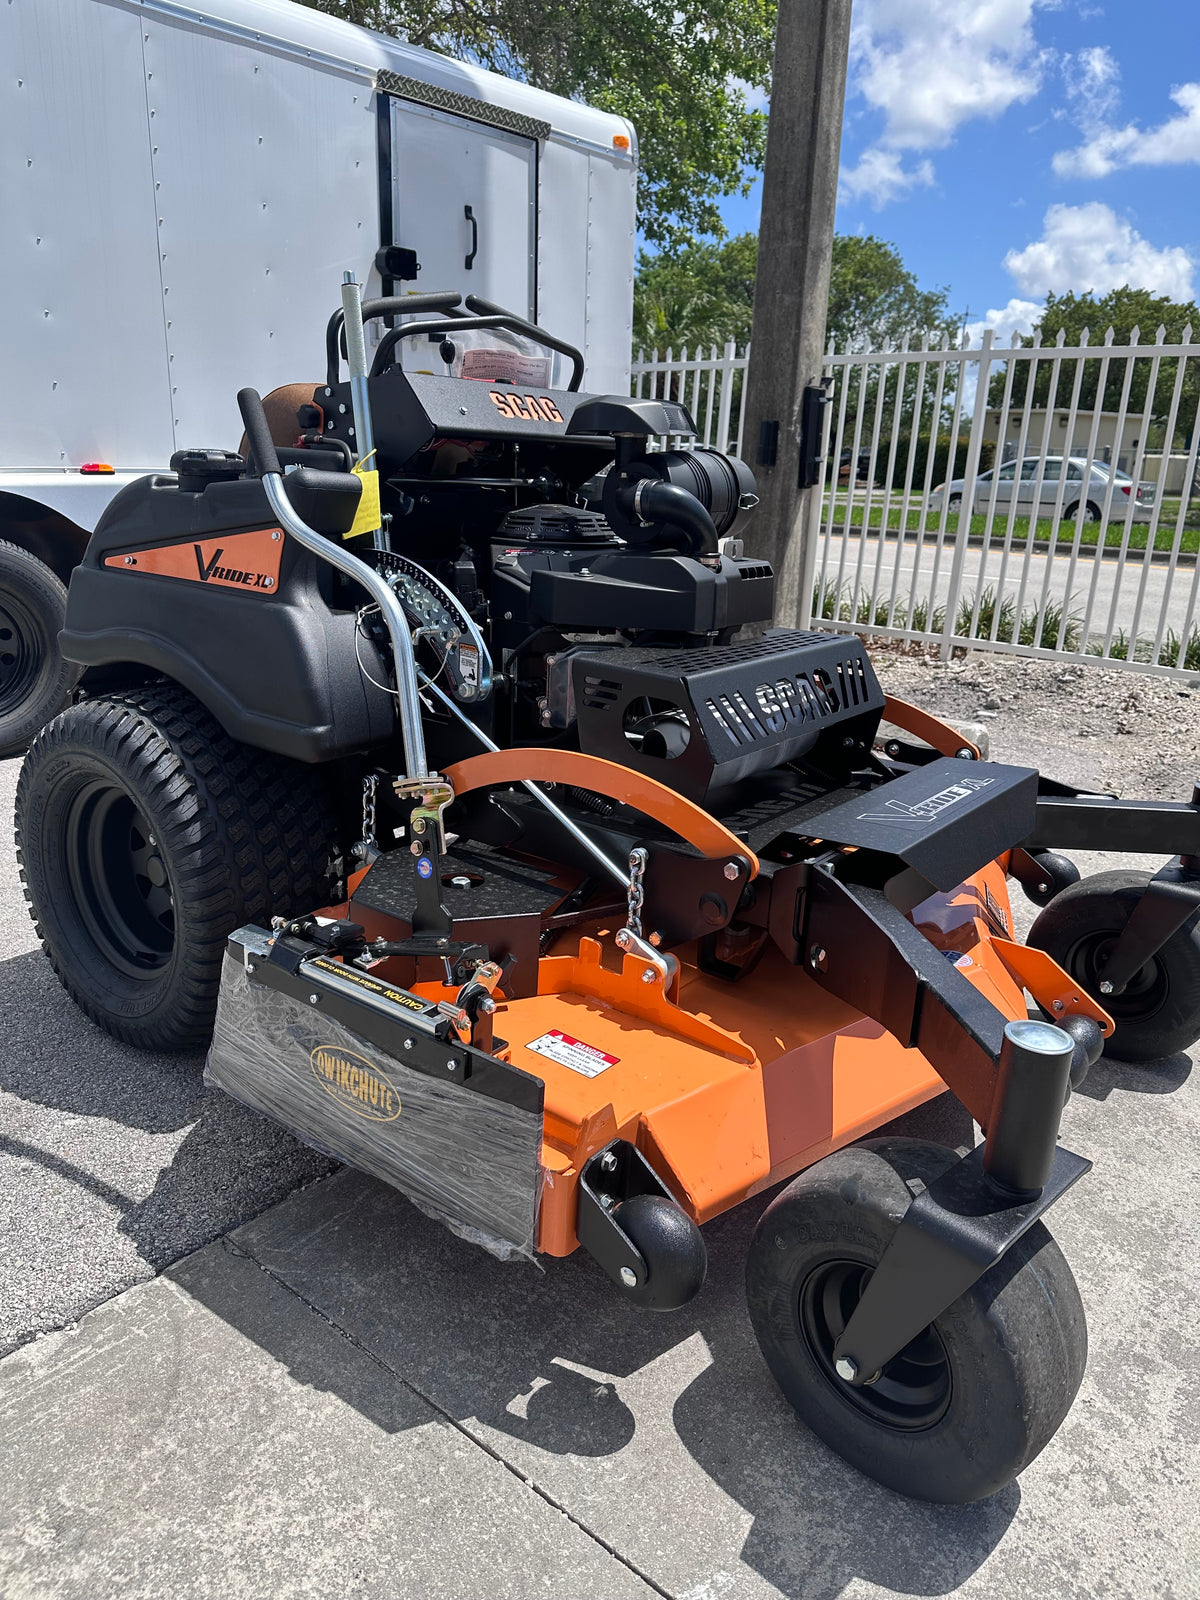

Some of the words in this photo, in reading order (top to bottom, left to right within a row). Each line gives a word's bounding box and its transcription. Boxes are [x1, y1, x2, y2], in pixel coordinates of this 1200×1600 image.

[488, 390, 564, 423] SCAG
[755, 668, 842, 733] SCAG
[383, 990, 424, 1010] CAUTION
[573, 1042, 606, 1059] DANGER
[317, 1050, 393, 1111] QWIKCHUTE
